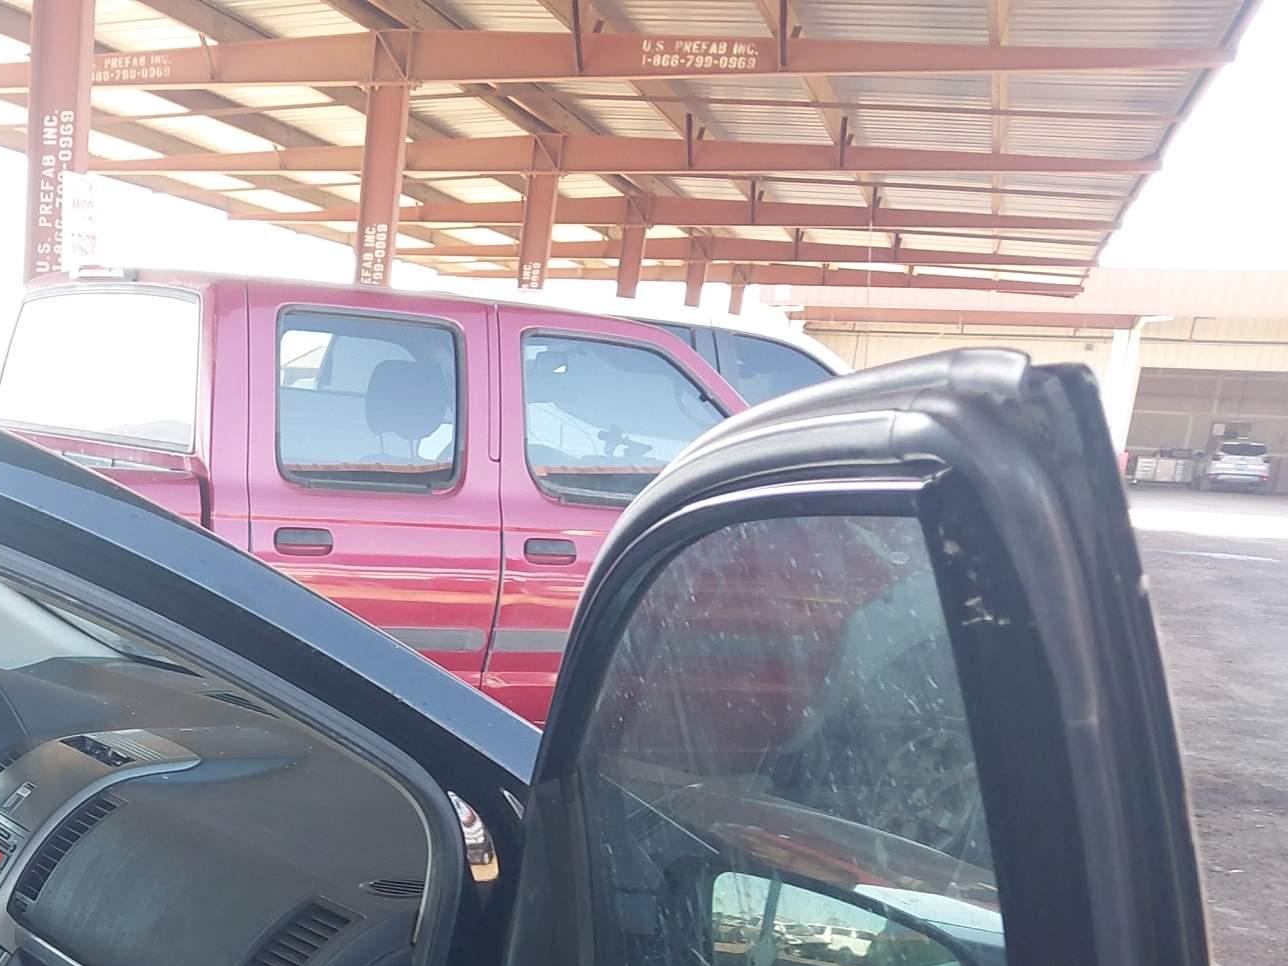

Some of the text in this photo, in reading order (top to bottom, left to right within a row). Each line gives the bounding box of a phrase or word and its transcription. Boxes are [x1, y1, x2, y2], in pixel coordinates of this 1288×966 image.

[675, 40, 727, 54] PREFAB
[733, 42, 759, 56] INC.
[104, 56, 146, 69] PREFAB
[641, 54, 757, 69] 1-866-799-0969
[36, 109, 59, 273] U.S. PREFAB INC.
